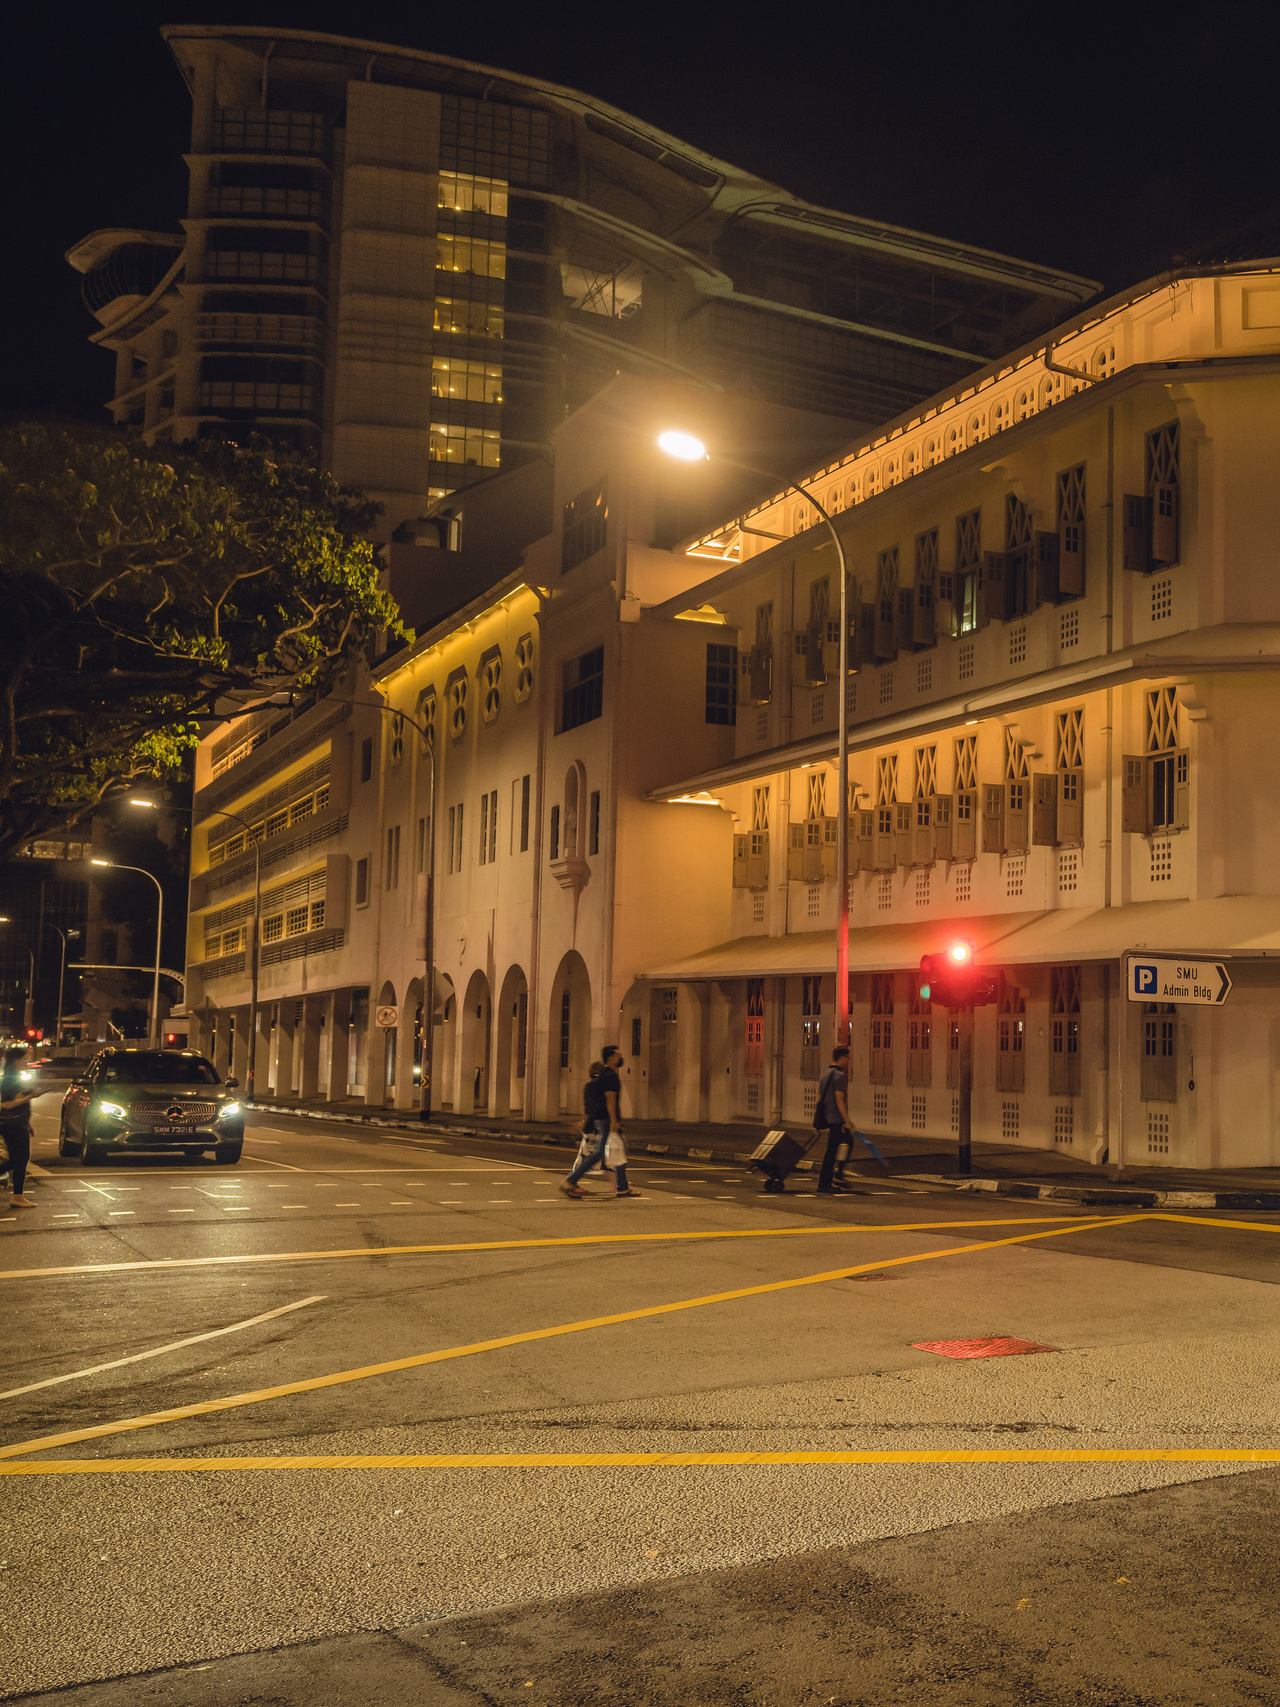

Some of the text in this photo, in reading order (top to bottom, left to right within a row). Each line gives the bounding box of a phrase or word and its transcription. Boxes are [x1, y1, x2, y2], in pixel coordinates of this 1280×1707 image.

[1176, 967, 1198, 980] SMU
[1163, 984, 1212, 1001] Admin Bldg
